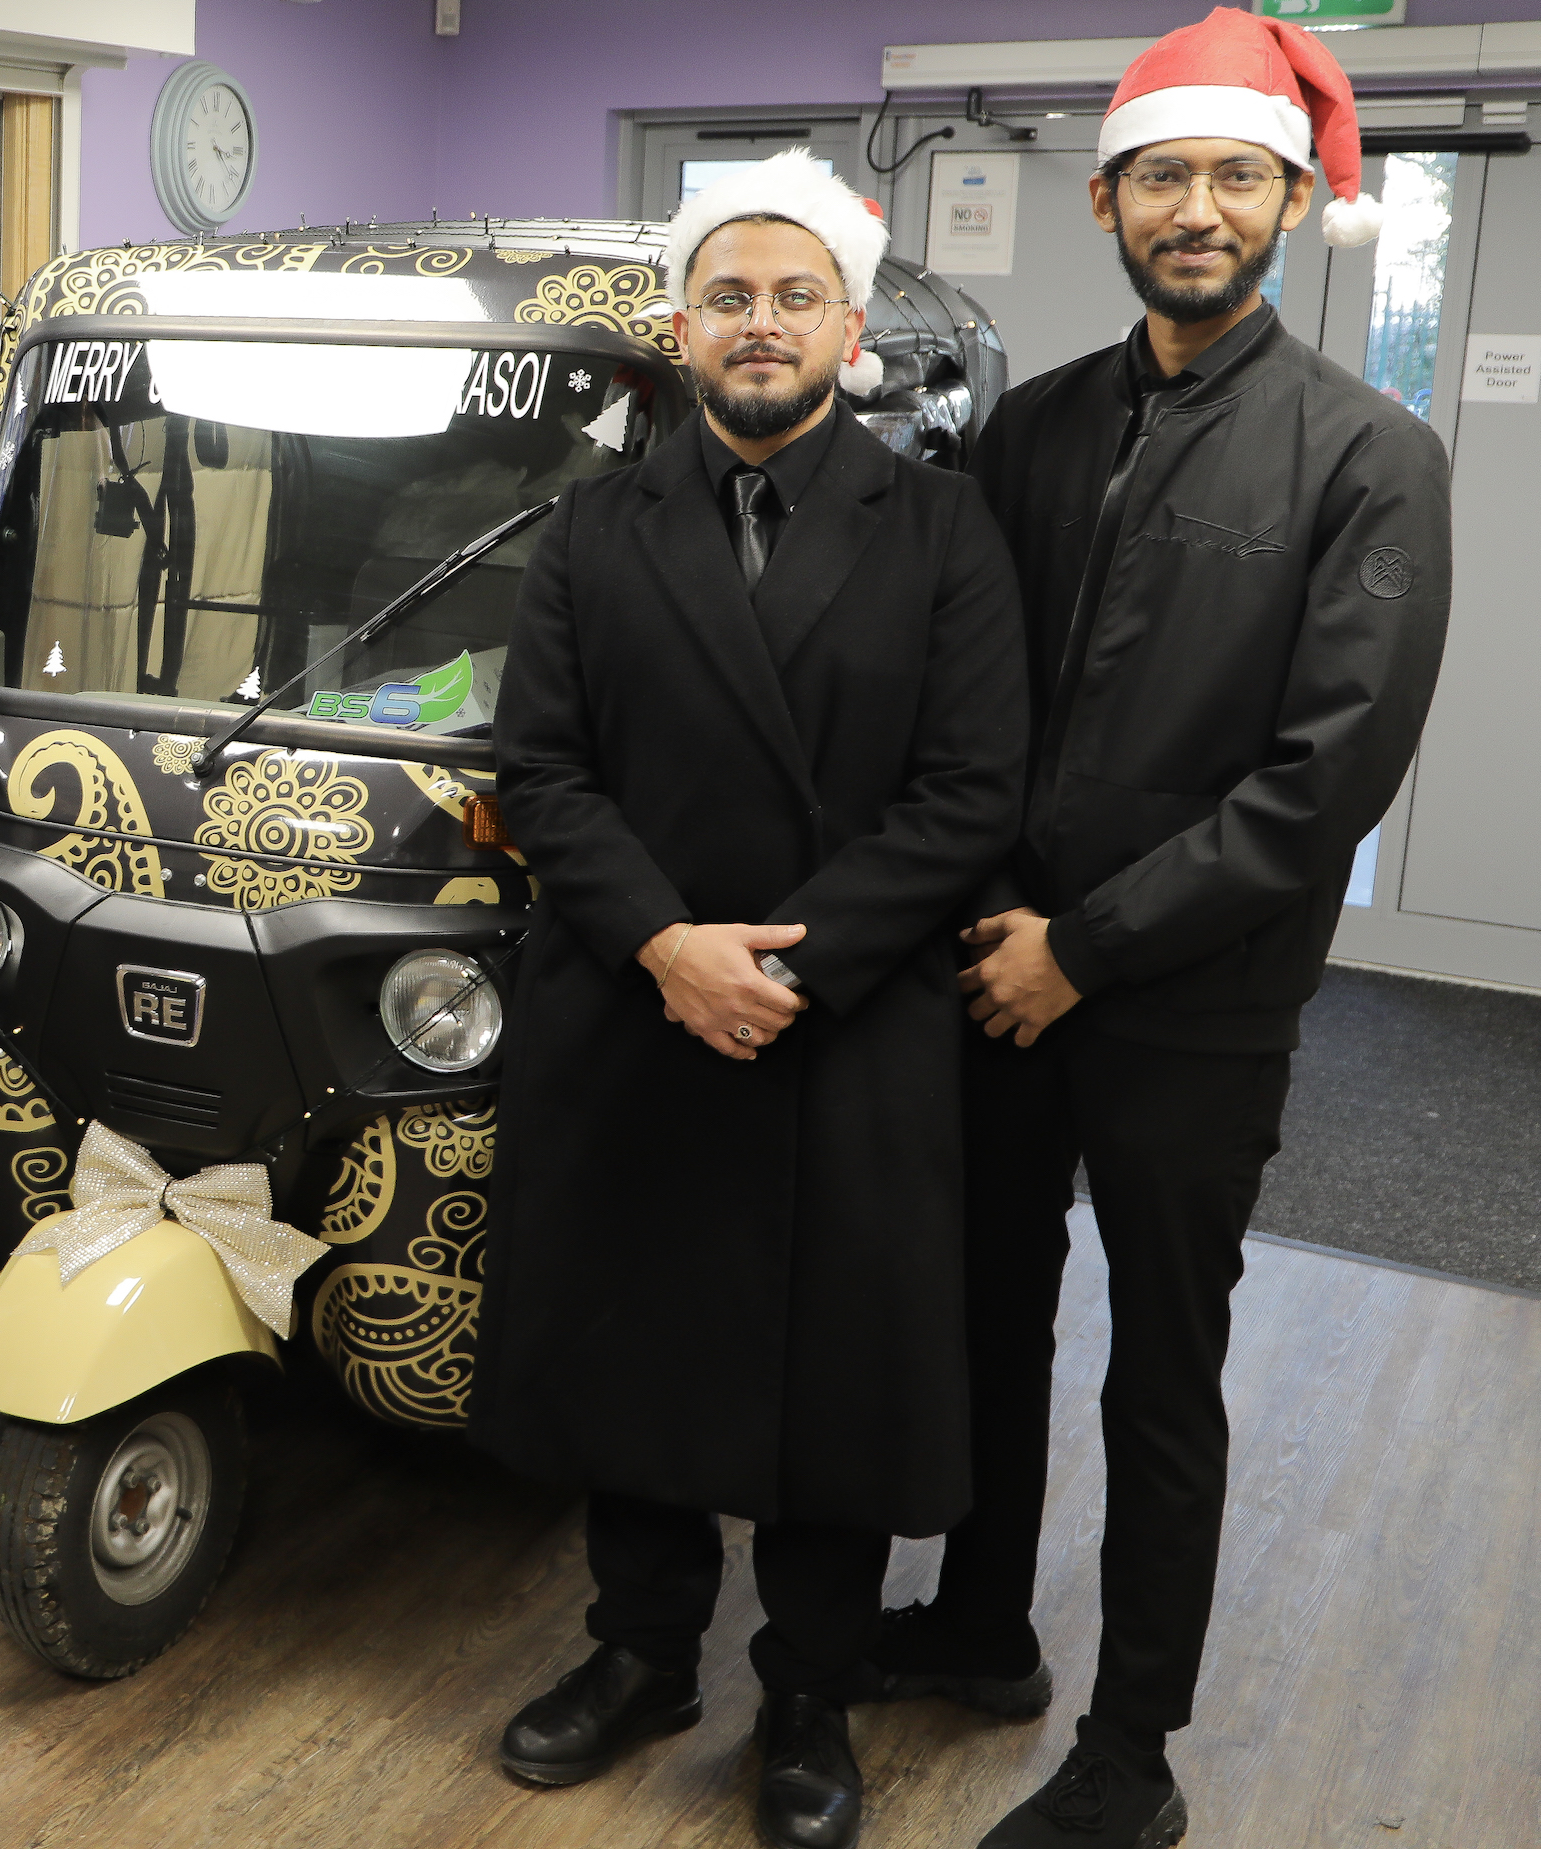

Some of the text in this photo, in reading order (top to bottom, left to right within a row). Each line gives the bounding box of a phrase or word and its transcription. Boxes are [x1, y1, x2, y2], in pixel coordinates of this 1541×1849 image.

[954, 207, 972, 221] NO
[1485, 350, 1525, 361] Power
[44, 341, 144, 405] MERRY
[1475, 364, 1531, 374] Assisted
[1486, 377, 1518, 388] Door
[307, 683, 422, 725] BS6
[141, 981, 178, 994] BAJAJ
[133, 990, 188, 1030] RE
